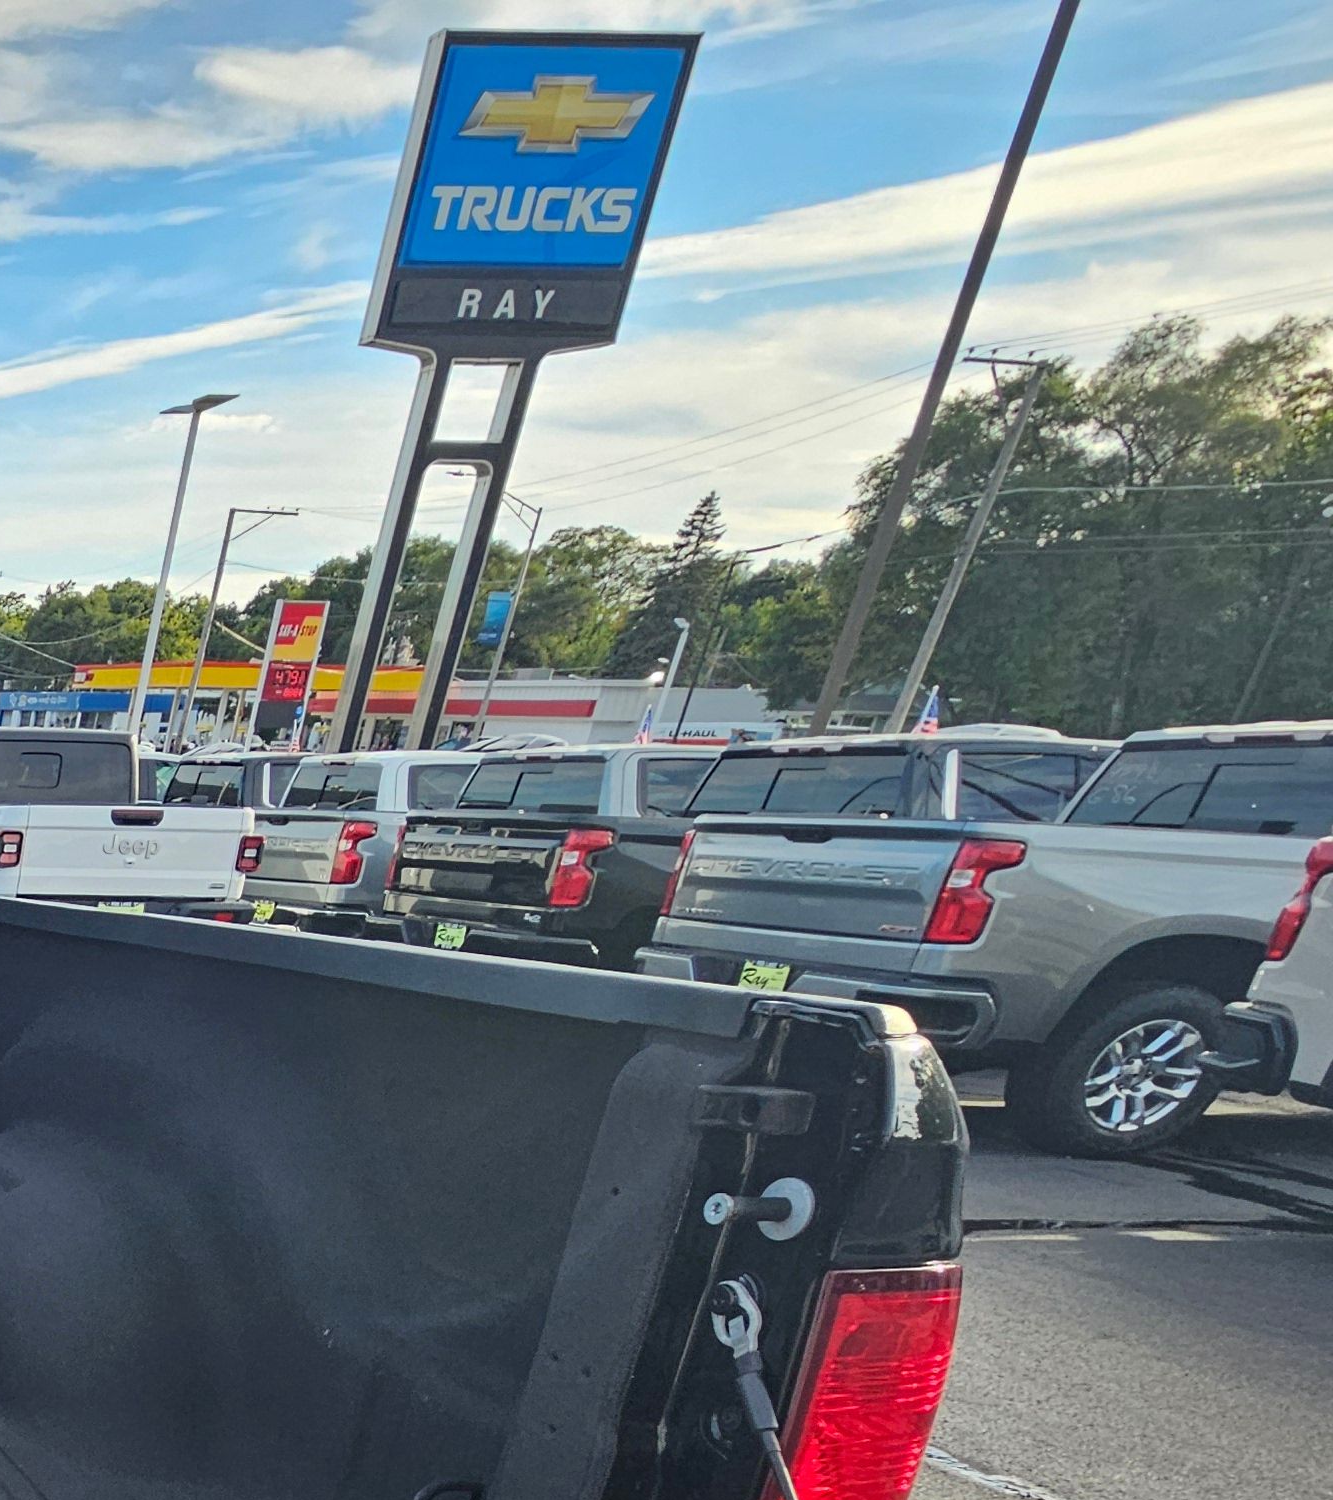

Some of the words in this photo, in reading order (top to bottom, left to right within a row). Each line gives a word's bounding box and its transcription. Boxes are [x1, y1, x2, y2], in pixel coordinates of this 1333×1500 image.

[431, 185, 637, 233] TRUCKS
[457, 288, 555, 319] RAY
[102, 833, 161, 860] Jeep
[403, 842, 546, 864] CHEVROLET
[691, 858, 921, 886] CHEVROLET
[742, 967, 770, 989] Ray
